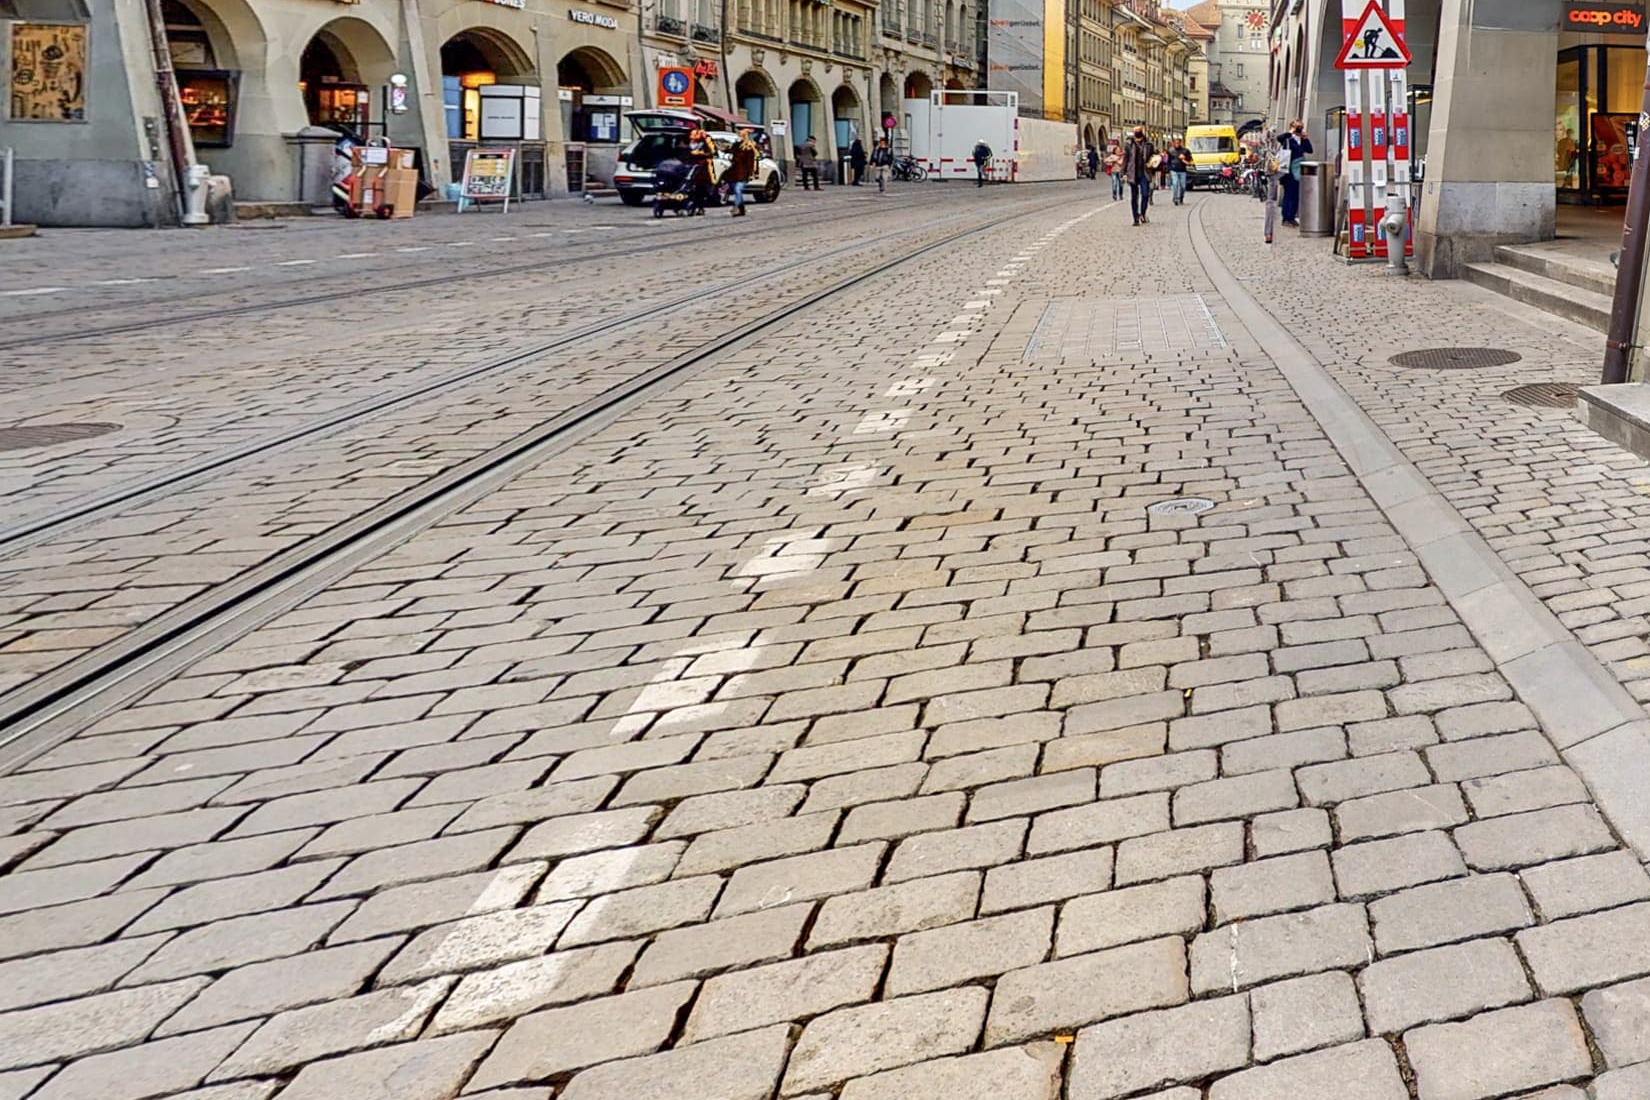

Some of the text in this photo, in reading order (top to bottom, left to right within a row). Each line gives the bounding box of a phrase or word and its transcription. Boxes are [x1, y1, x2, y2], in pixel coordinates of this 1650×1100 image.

[572, 10, 619, 29] VERO MODA
[1569, 9, 1642, 27] coop city
